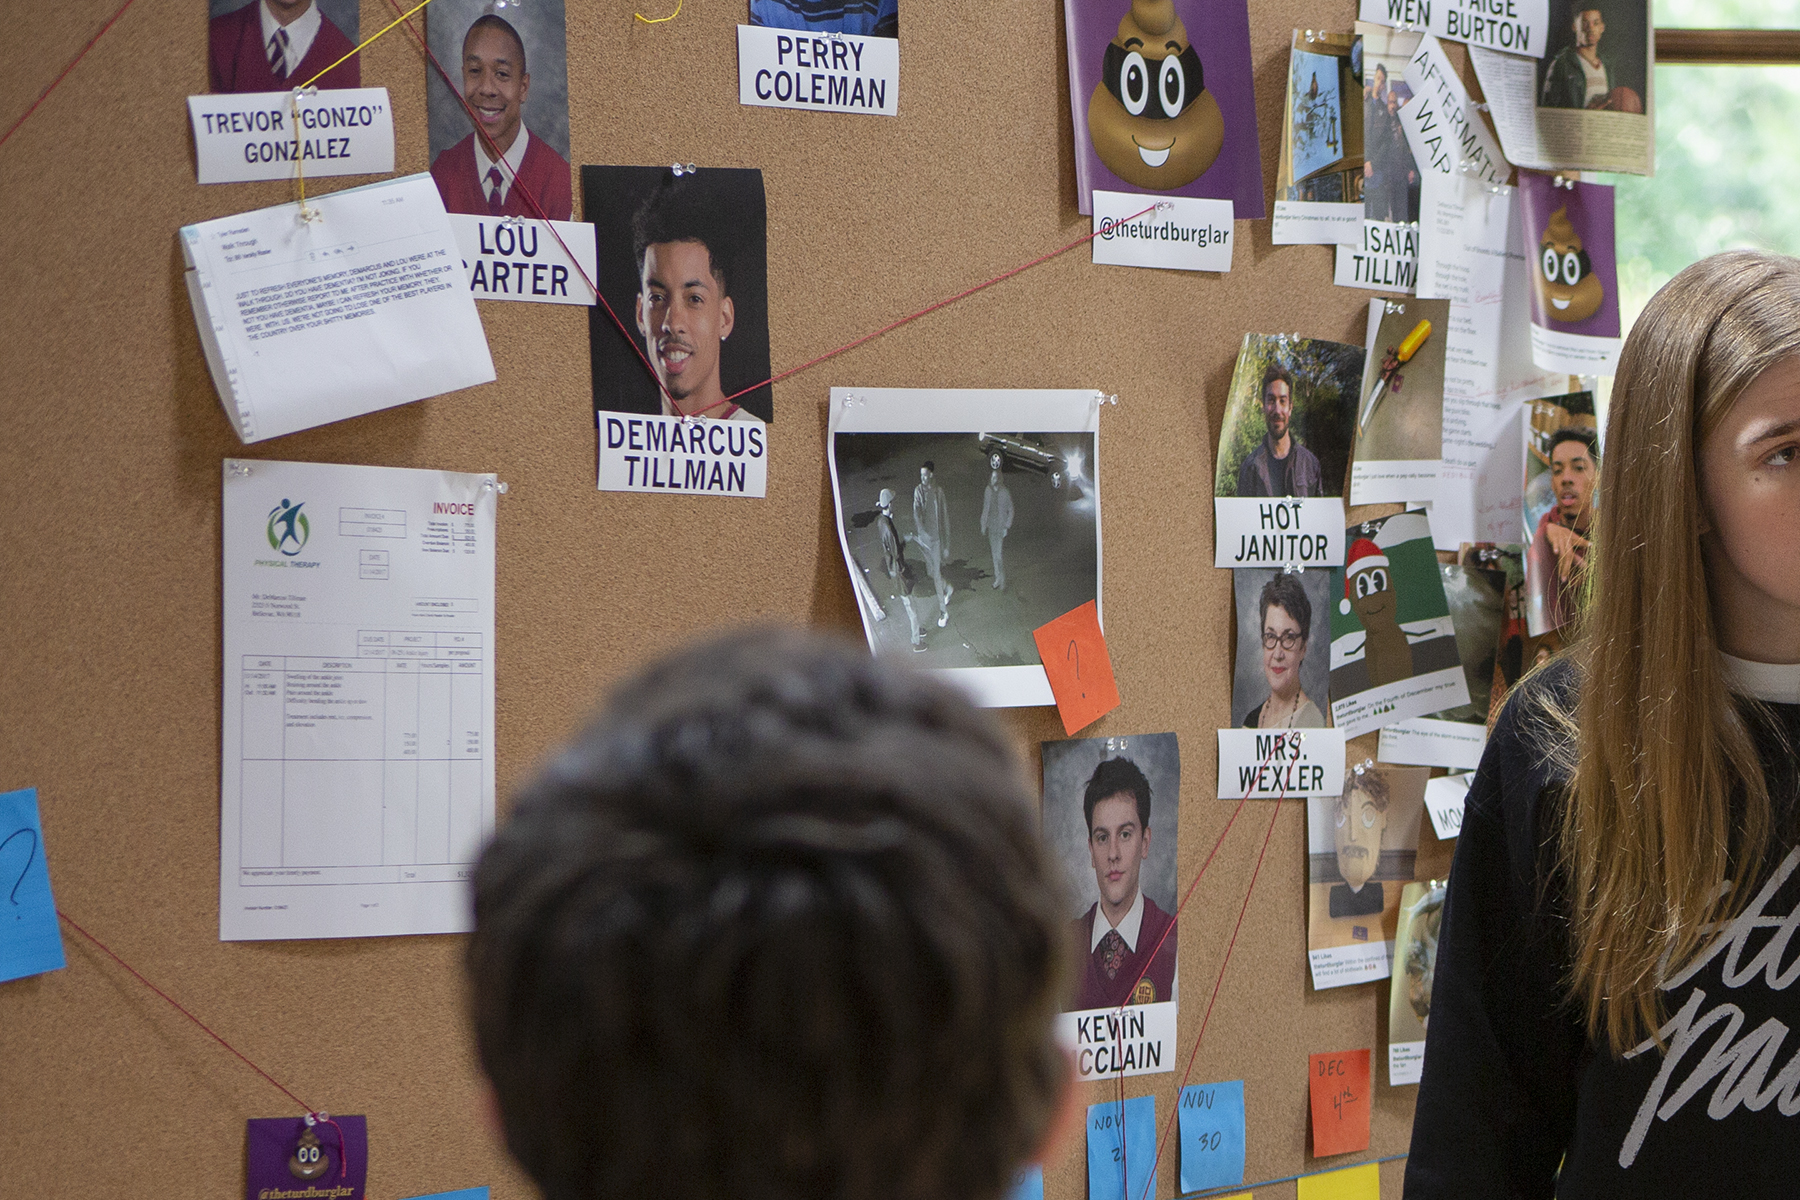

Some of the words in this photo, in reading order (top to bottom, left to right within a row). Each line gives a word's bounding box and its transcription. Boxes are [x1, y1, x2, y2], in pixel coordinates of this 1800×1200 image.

[1448, 10, 1529, 51] BURTON
[777, 36, 864, 71] PERRY
[756, 69, 885, 108] COLEMAN
[202, 110, 284, 134] TREVOR
[245, 138, 351, 163] GONZALEZ
[479, 222, 538, 258] LOU
[1100, 216, 1229, 248] @theturdburglar
[1364, 226, 1419, 258] ISAIA
[462, 259, 568, 296] ARTER
[607, 418, 764, 458] DEMARCUS
[624, 456, 745, 492] TILLMAN
[433, 502, 474, 516] INVOICE
[1260, 503, 1302, 530] HOT
[1235, 534, 1328, 562] JANITOR
[254, 560, 288, 568] PHYSICAL
[290, 560, 320, 569] THERAPY
[1066, 639, 1086, 699] ?
[1256, 734, 1306, 760] MRS.
[1239, 766, 1324, 792] WEXLER
[1078, 1011, 1144, 1044] KEVIN
[1075, 1041, 1161, 1076] CCLAIN
[1318, 1059, 1345, 1076] DEC
[1184, 1090, 1215, 1110] NOV
[1094, 1114, 1124, 1130] NOV
[1198, 1131, 1222, 1151] 30
